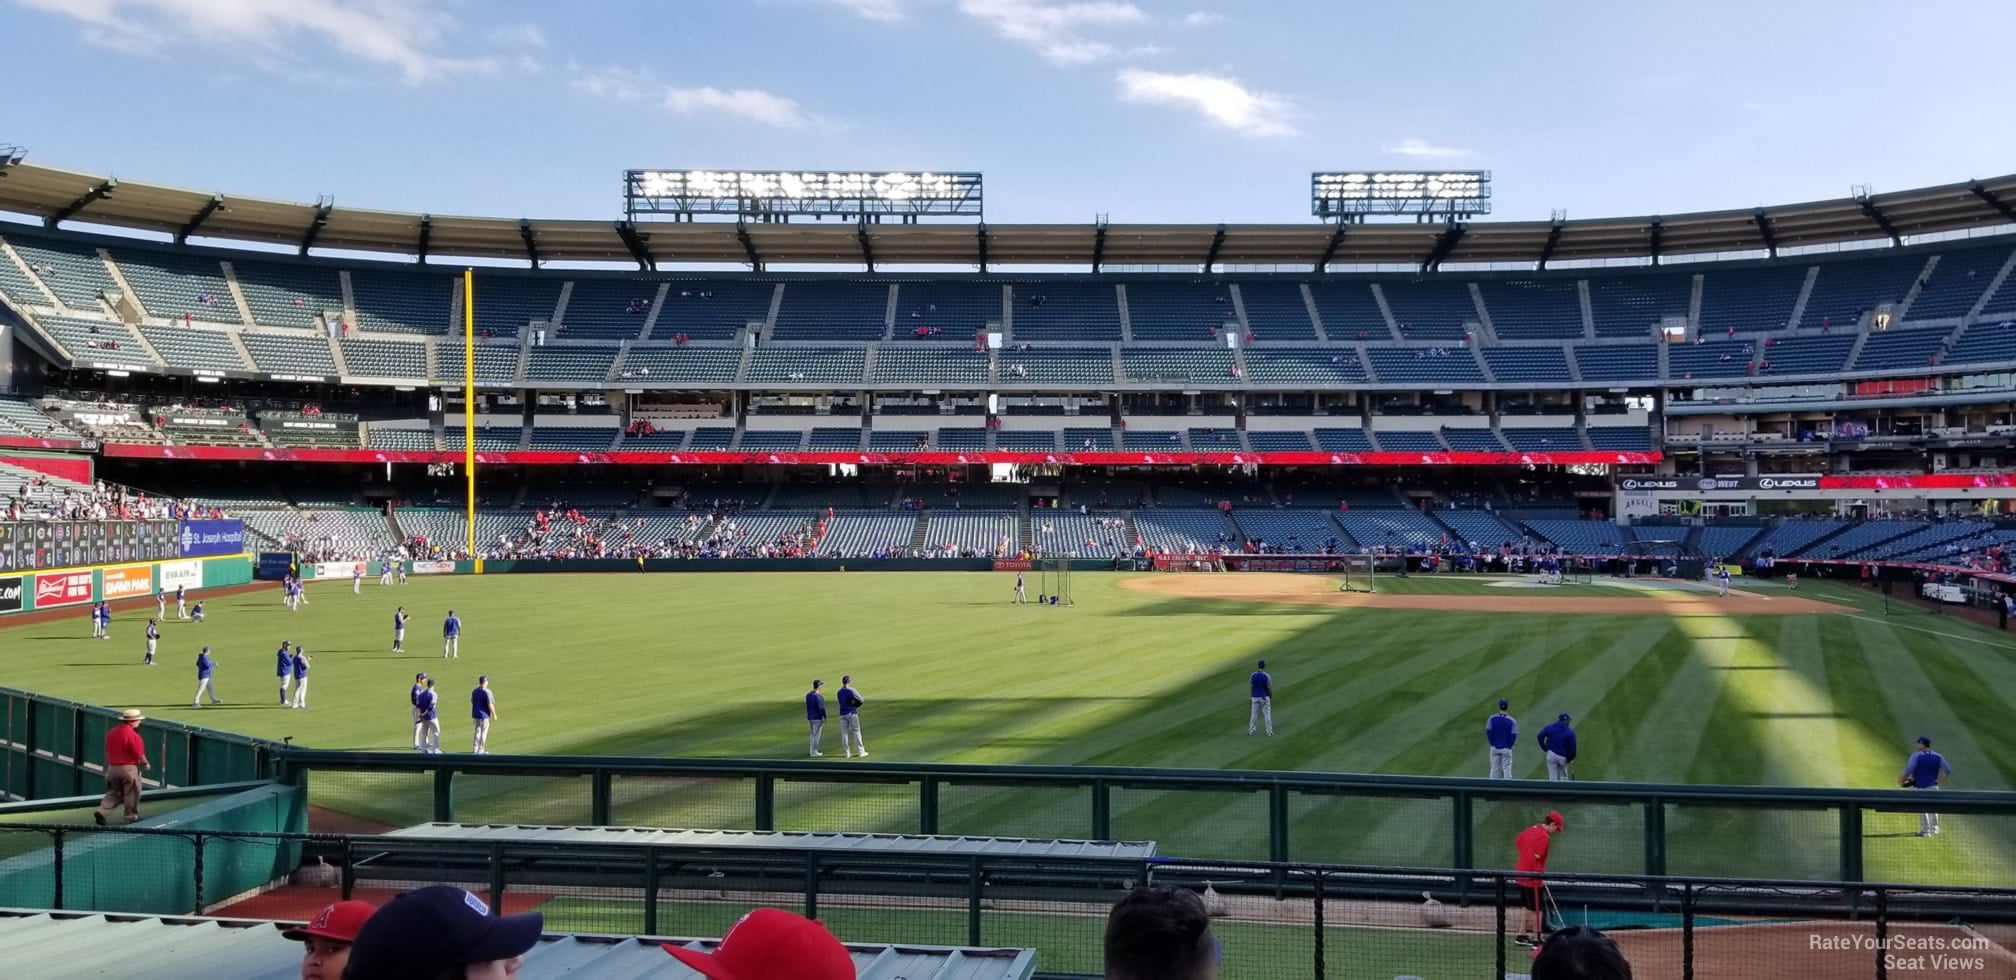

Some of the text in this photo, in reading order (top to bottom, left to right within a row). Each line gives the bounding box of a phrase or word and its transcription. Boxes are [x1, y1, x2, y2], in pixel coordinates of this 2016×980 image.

[80, 440, 97, 449] 5:00
[1775, 479, 1817, 487] LEXUS
[1625, 499, 1653, 509] ANGELS
[202, 532, 221, 545] Joseph
[222, 531, 242, 544] Hospital
[312, 904, 335, 929] A
